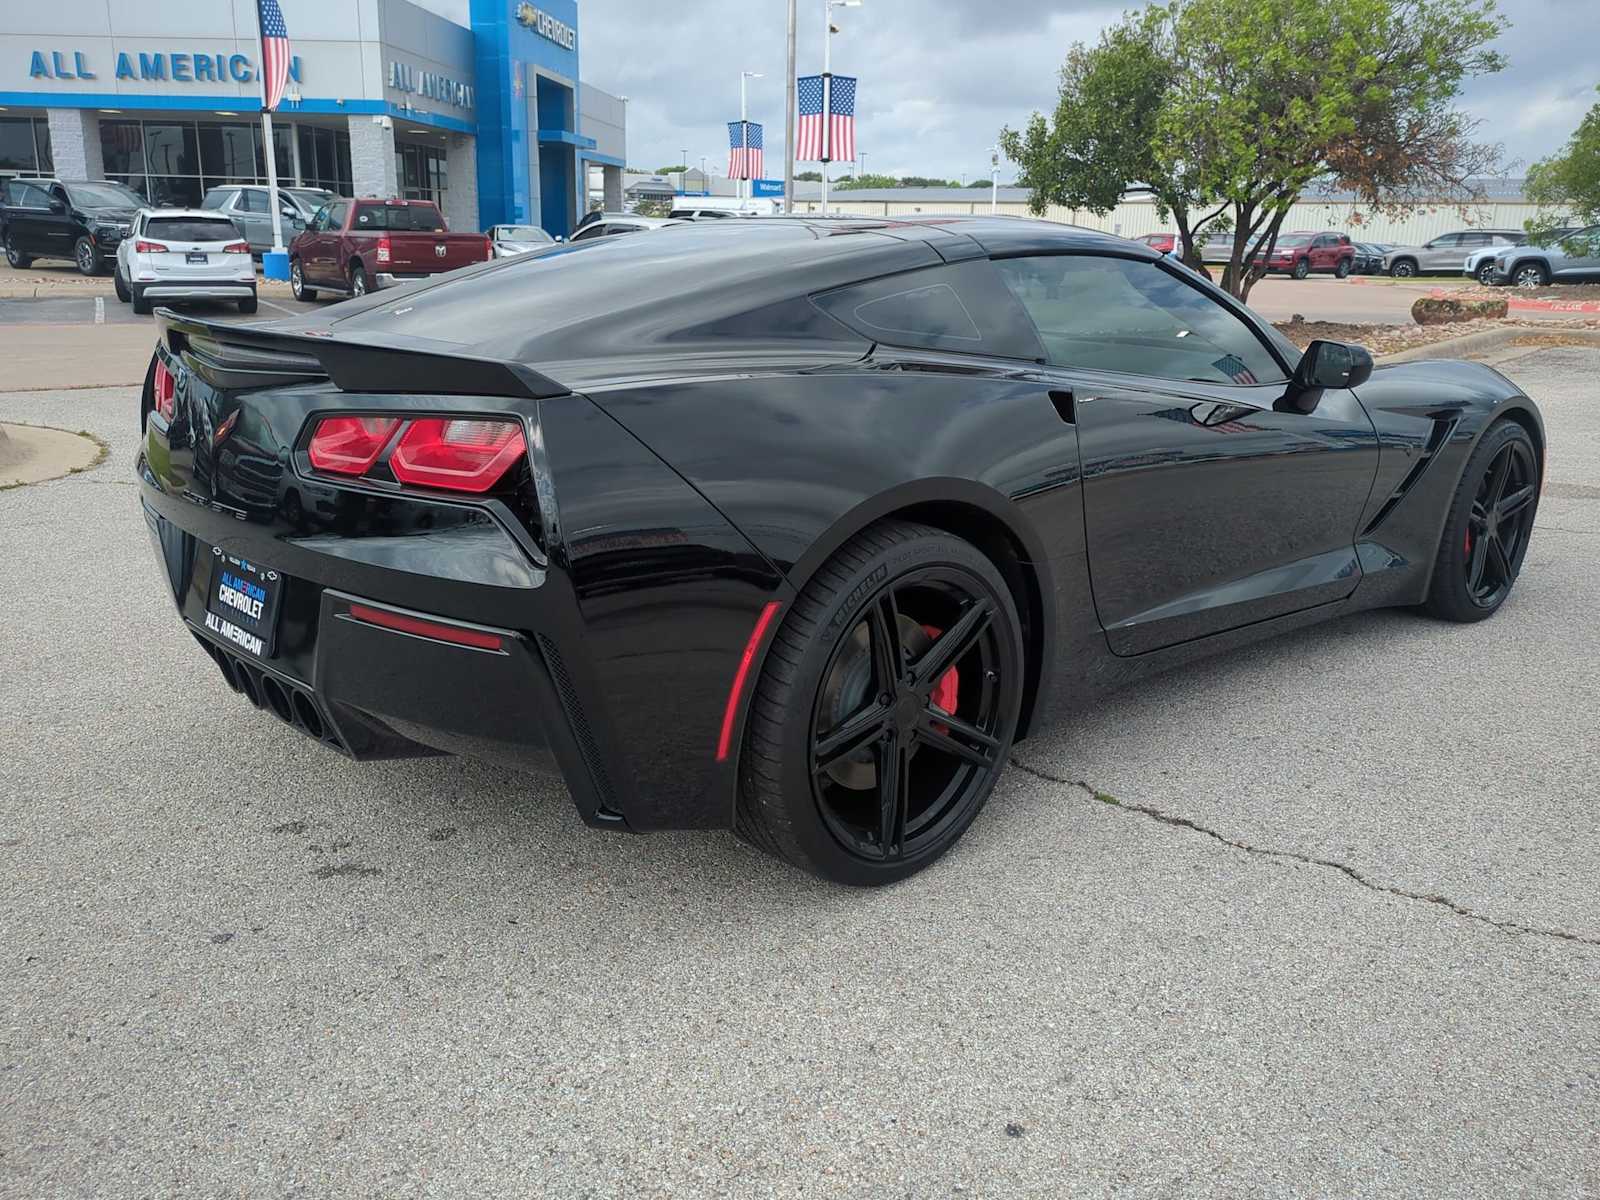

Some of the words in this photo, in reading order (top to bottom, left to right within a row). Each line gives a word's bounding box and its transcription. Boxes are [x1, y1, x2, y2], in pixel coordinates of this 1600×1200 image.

[537, 8, 576, 51] CHEVROLET
[30, 51, 94, 79] ALL
[116, 52, 302, 82] AMERICN
[389, 61, 416, 92] ALL
[417, 71, 475, 110] AMERICAN
[760, 183, 782, 192] Walmart
[219, 583, 264, 620] CHEVROLET
[222, 571, 235, 587] ALL
[233, 576, 266, 602] AMERICAN
[205, 611, 220, 633] ALL
[219, 618, 263, 656] AMERICAN
